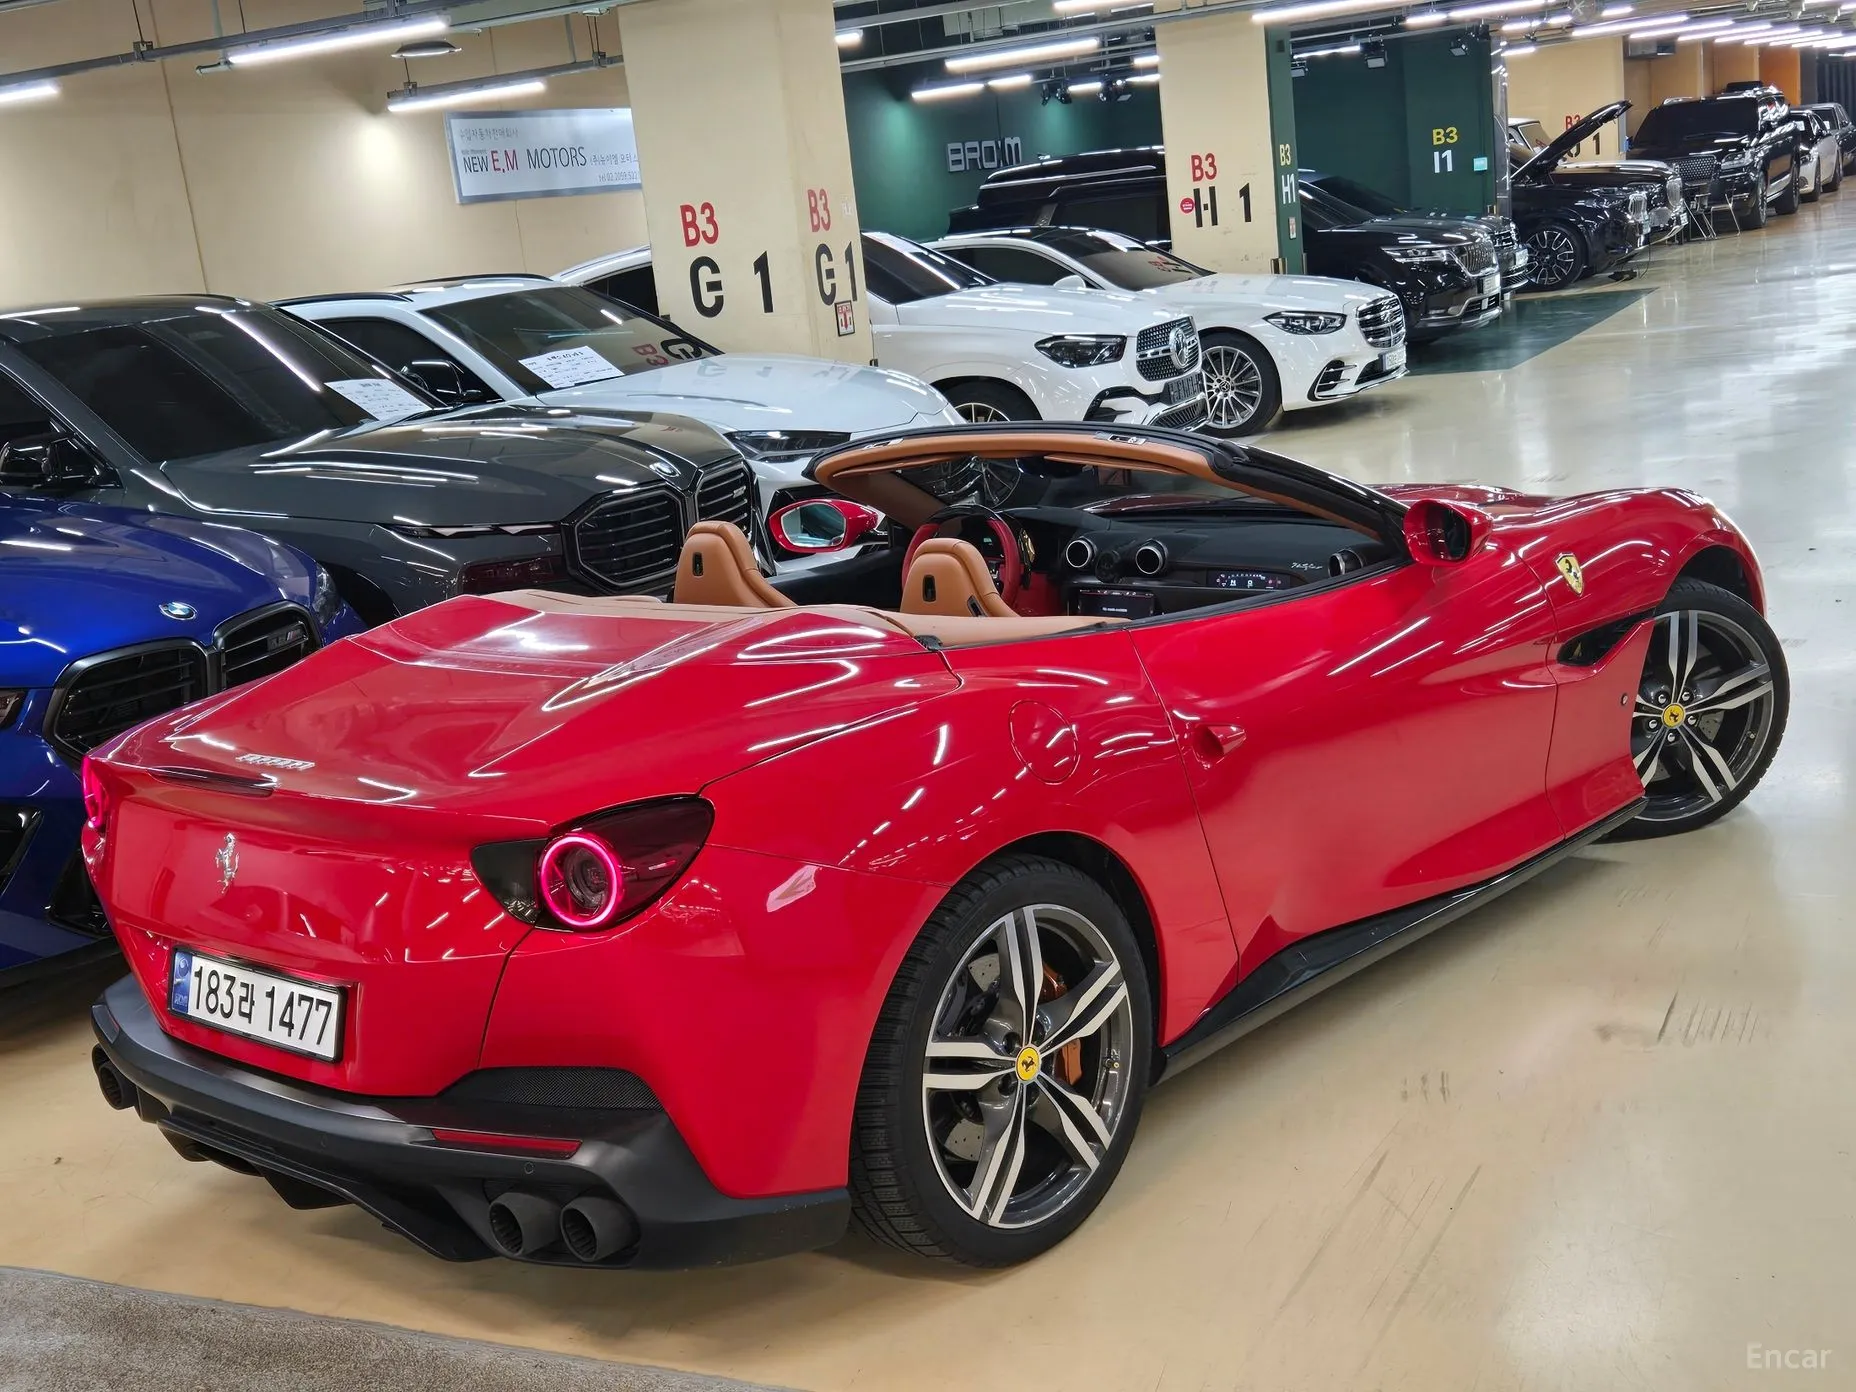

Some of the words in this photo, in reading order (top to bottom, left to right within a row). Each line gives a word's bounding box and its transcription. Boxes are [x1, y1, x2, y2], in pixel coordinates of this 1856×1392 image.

[1432, 126, 1458, 146] B3
[1593, 131, 1600, 155] 1
[463, 155, 489, 174] NEW
[527, 146, 587, 170] MOTORS
[1191, 152, 1218, 182] B3
[1279, 143, 1291, 167] B3
[1239, 182, 1252, 223] 1
[1281, 172, 1296, 205] H1
[679, 201, 719, 247] B3
[807, 188, 831, 233] B3
[689, 255, 724, 318] G
[752, 250, 774, 313] 1
[815, 243, 837, 306] G
[844, 241, 858, 302] 1
[193, 965, 255, 1025] 183라
[265, 985, 333, 1046] 1477
